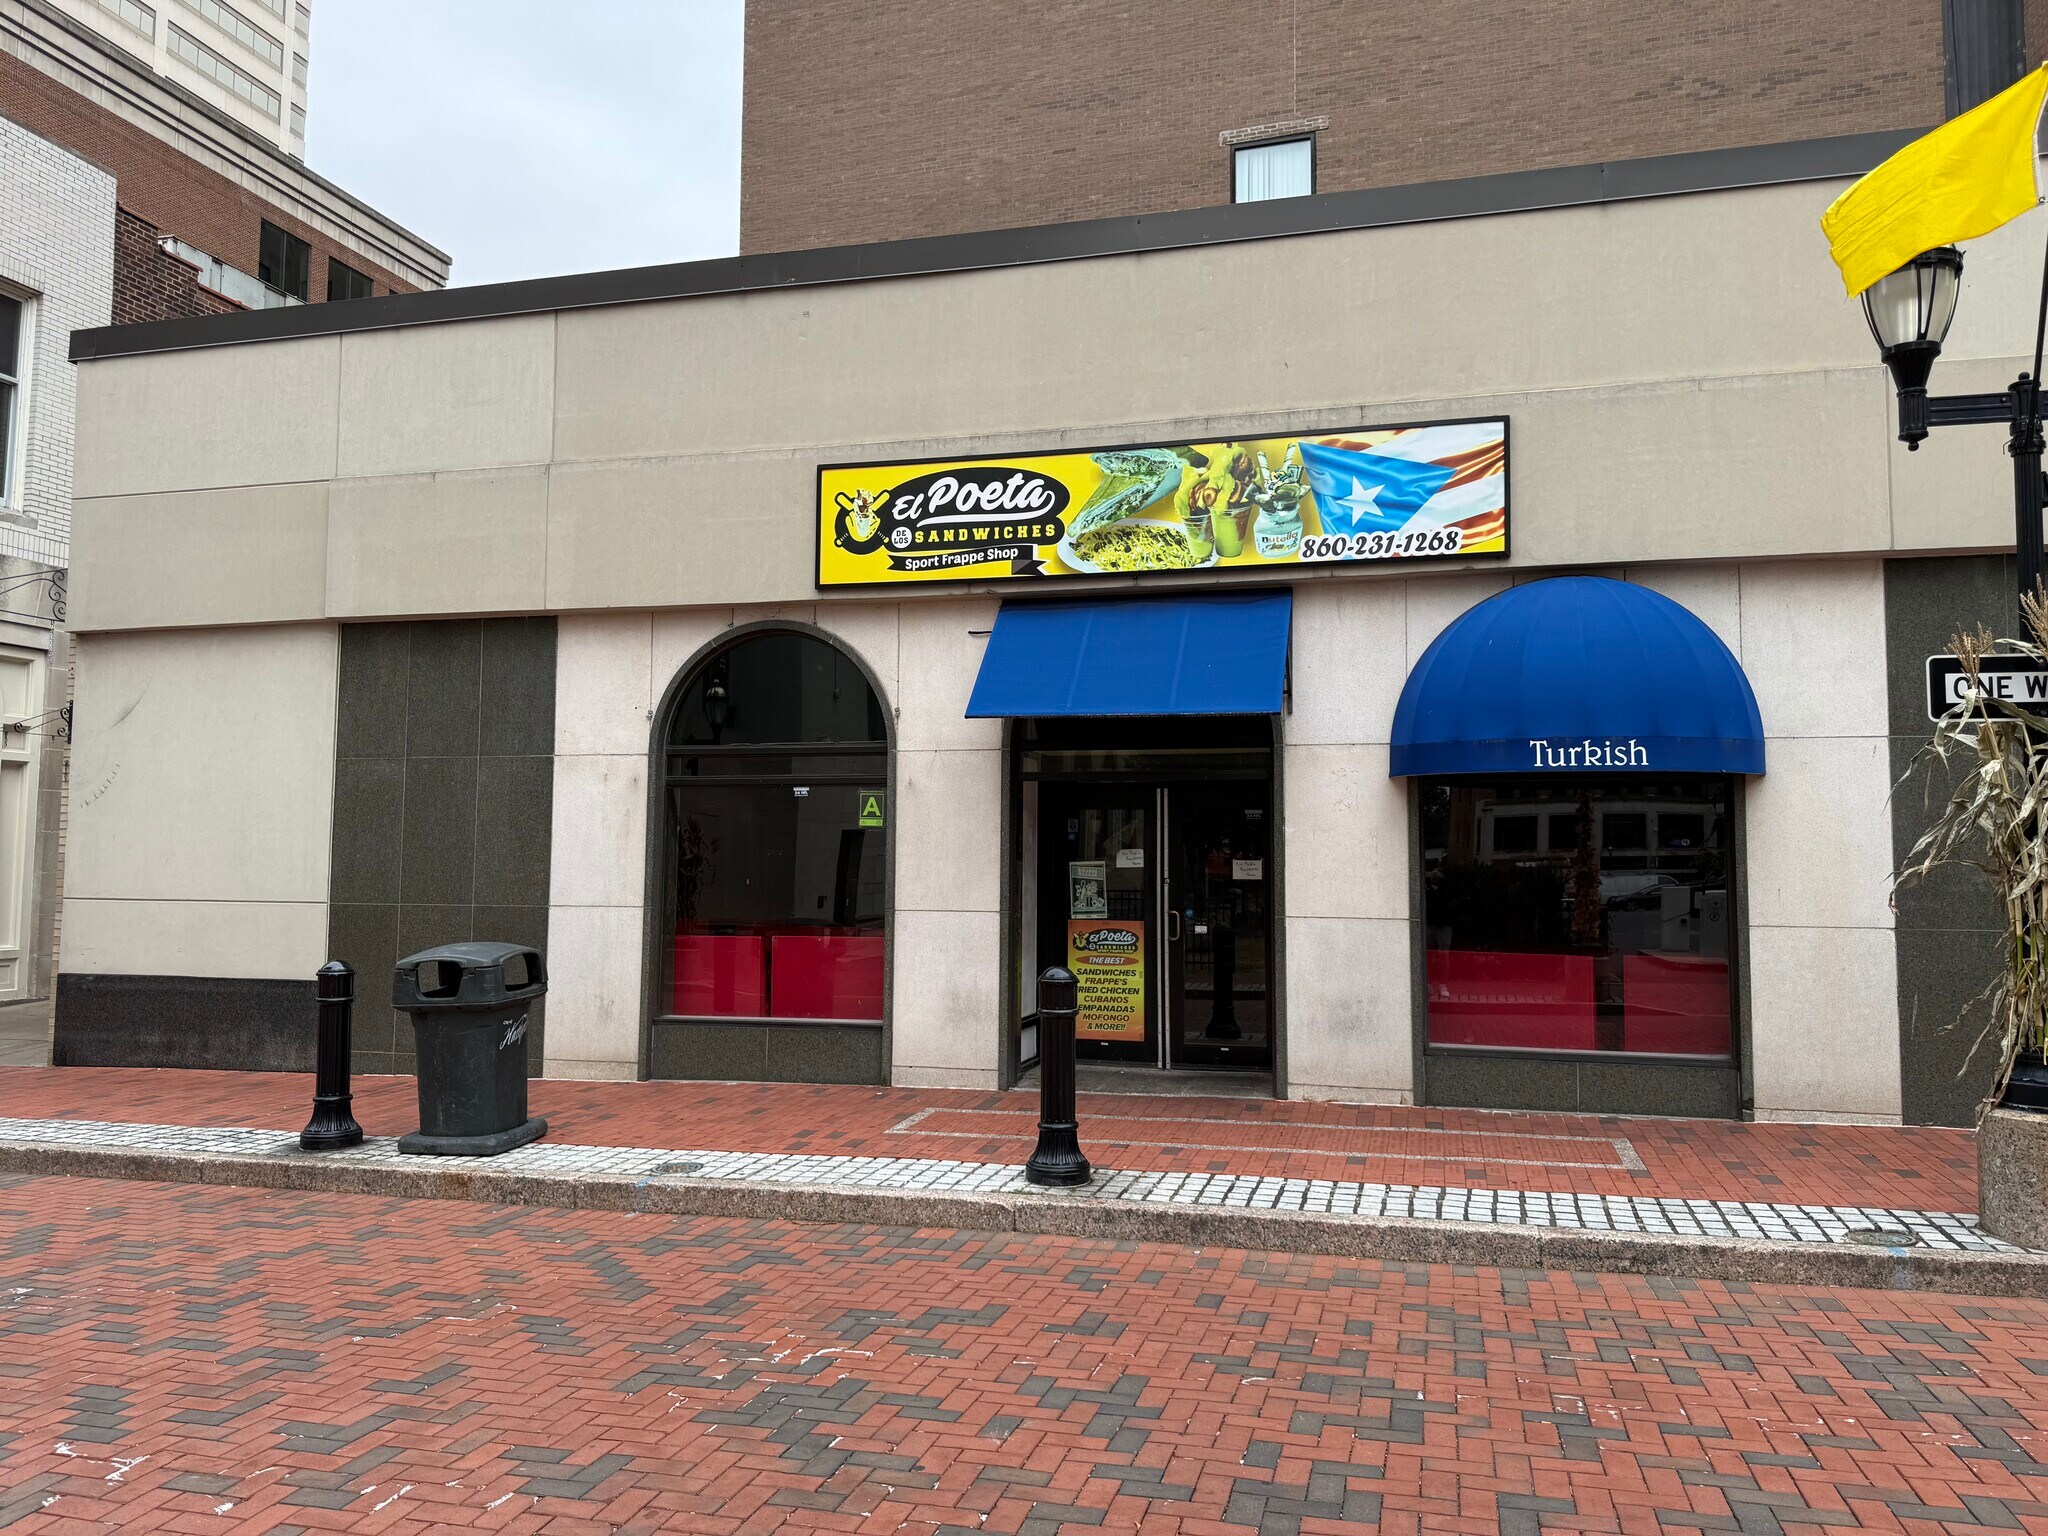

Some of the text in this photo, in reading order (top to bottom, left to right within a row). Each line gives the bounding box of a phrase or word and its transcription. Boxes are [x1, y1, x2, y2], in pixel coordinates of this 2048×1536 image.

[892, 472, 1056, 520] El Poeta
[914, 524, 1056, 544] SANDWICHES
[893, 537, 909, 545] LOS
[1302, 531, 1459, 558] 860-231-1268
[905, 547, 1019, 571] Sport Frappe Shop
[1953, 676, 2014, 699] ONE
[1529, 739, 1649, 767] Turkish
[862, 797, 881, 816] A
[1089, 930, 1136, 942] El Poeta
[1104, 957, 1126, 965] BEST
[1076, 968, 1137, 977] SANDWICHES
[1085, 977, 1128, 986] FRAPPE'S
[1100, 987, 1140, 995] CHICKEN
[1083, 995, 1129, 1004] CUBANOS
[1078, 1004, 1136, 1013] EMPANADAS
[1082, 1014, 1130, 1022] MOFONGO
